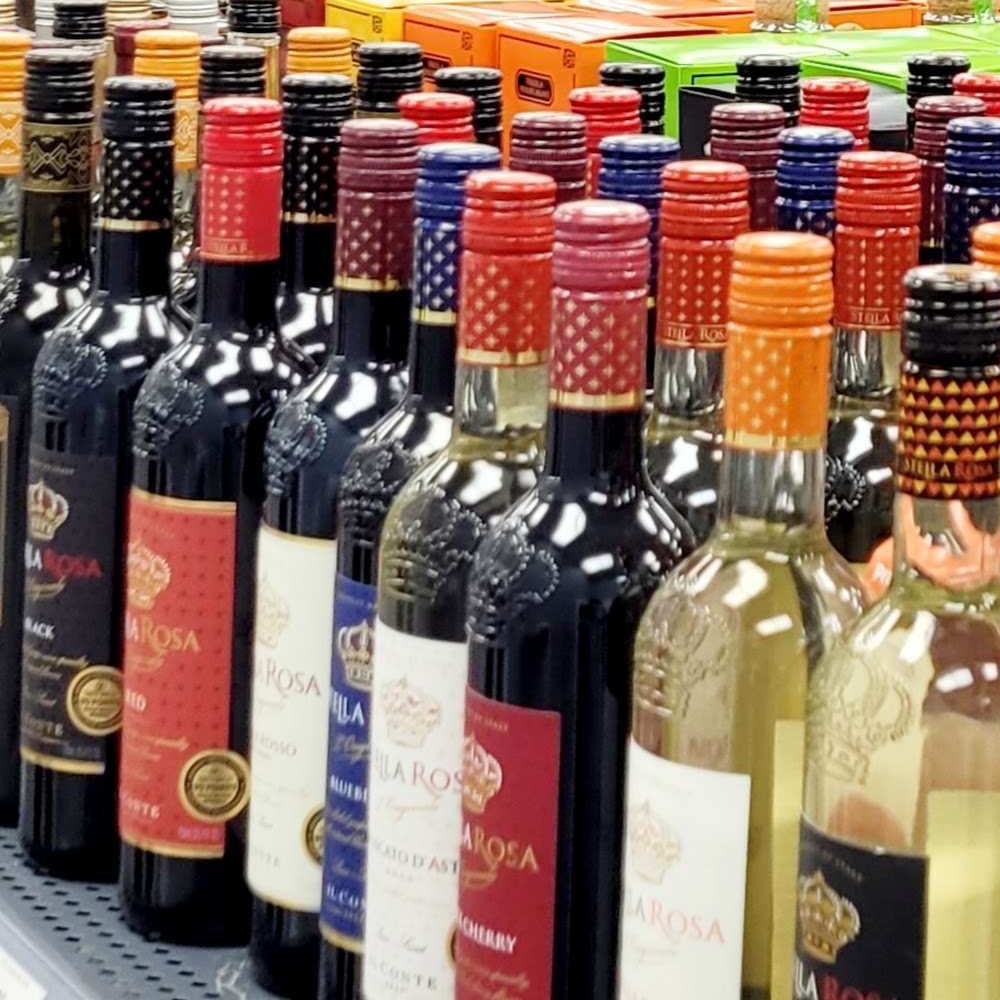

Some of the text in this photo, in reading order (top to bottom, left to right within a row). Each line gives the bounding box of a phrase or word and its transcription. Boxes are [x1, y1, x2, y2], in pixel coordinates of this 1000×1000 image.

[904, 458, 951, 479] STELLA
[43, 548, 104, 580] ROSA
[141, 616, 200, 656] ROSA
[266, 658, 321, 698] ROSA
[475, 825, 539, 874] ROSA
[463, 916, 517, 953] CHERRY
[649, 899, 725, 944] ROSA
